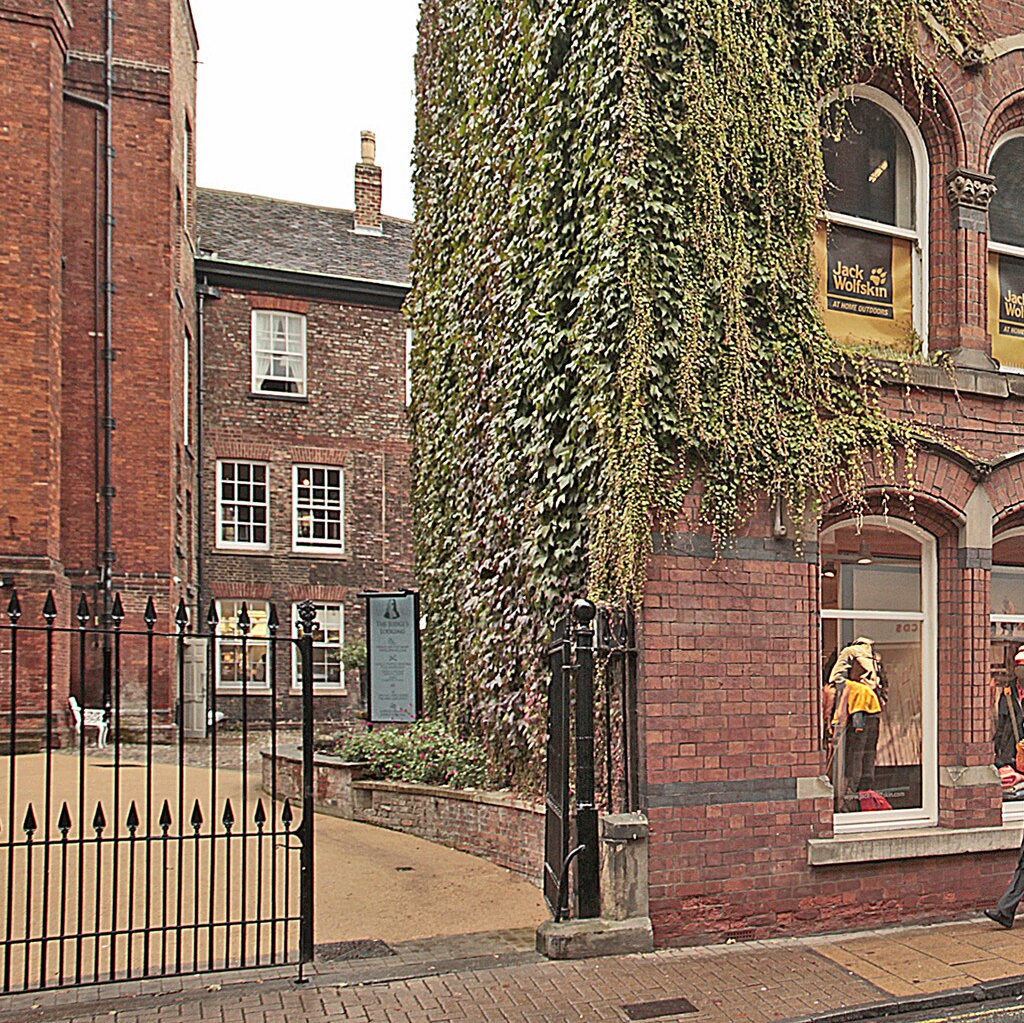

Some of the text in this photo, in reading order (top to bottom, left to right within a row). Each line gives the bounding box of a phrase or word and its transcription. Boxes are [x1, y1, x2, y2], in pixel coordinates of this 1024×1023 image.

[832, 261, 863, 279] Jack
[833, 275, 887, 297] Wolfskin
[840, 302, 857, 312] HOME
[858, 305, 889, 316] OUTDOORS
